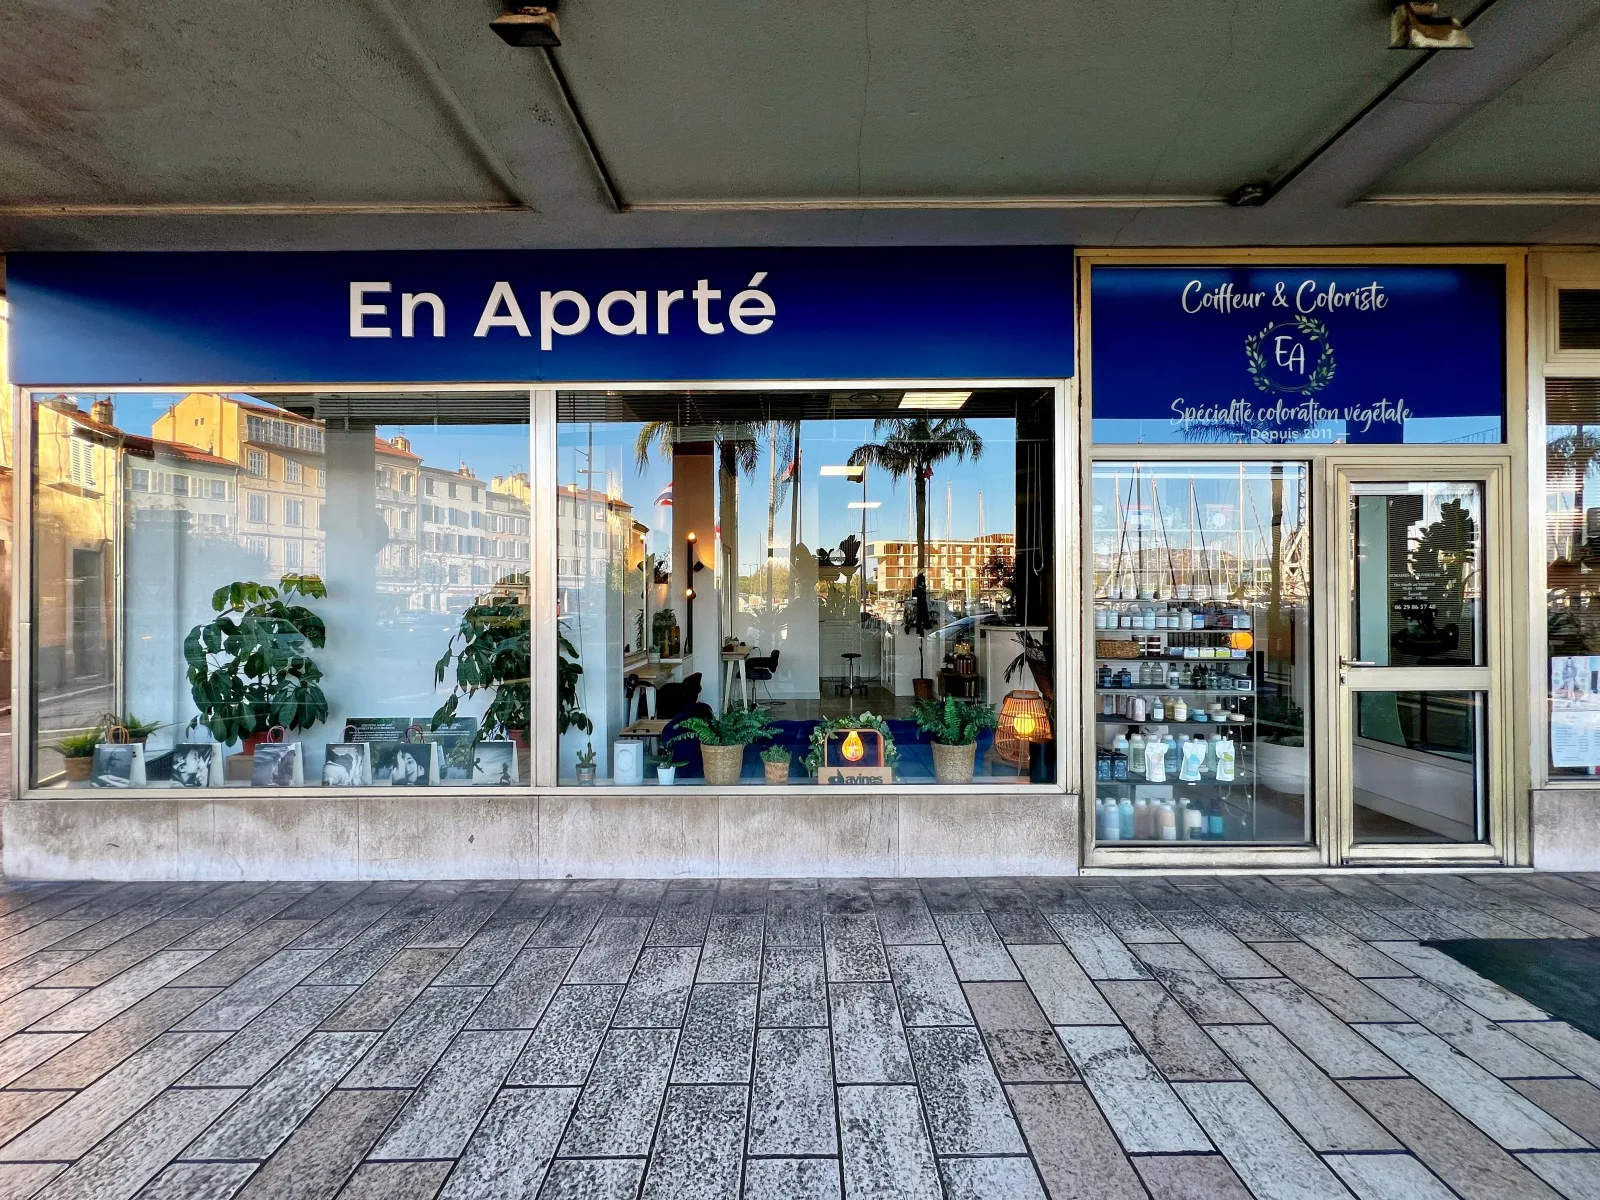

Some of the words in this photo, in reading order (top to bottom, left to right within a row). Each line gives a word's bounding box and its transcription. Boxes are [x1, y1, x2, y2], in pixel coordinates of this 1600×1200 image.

[349, 281, 446, 338] En
[473, 271, 777, 351] Aparté
[1181, 279, 1265, 314] Coiffeur
[1272, 281, 1289, 308] &
[1296, 279, 1389, 314] Coloriste
[1275, 335, 1305, 375] EA
[1170, 397, 1254, 432] Spécialité
[1257, 398, 1339, 425] coloration
[1344, 398, 1413, 433] végétale
[1303, 428, 1332, 440] 2011
[828, 768, 884, 785] davines
